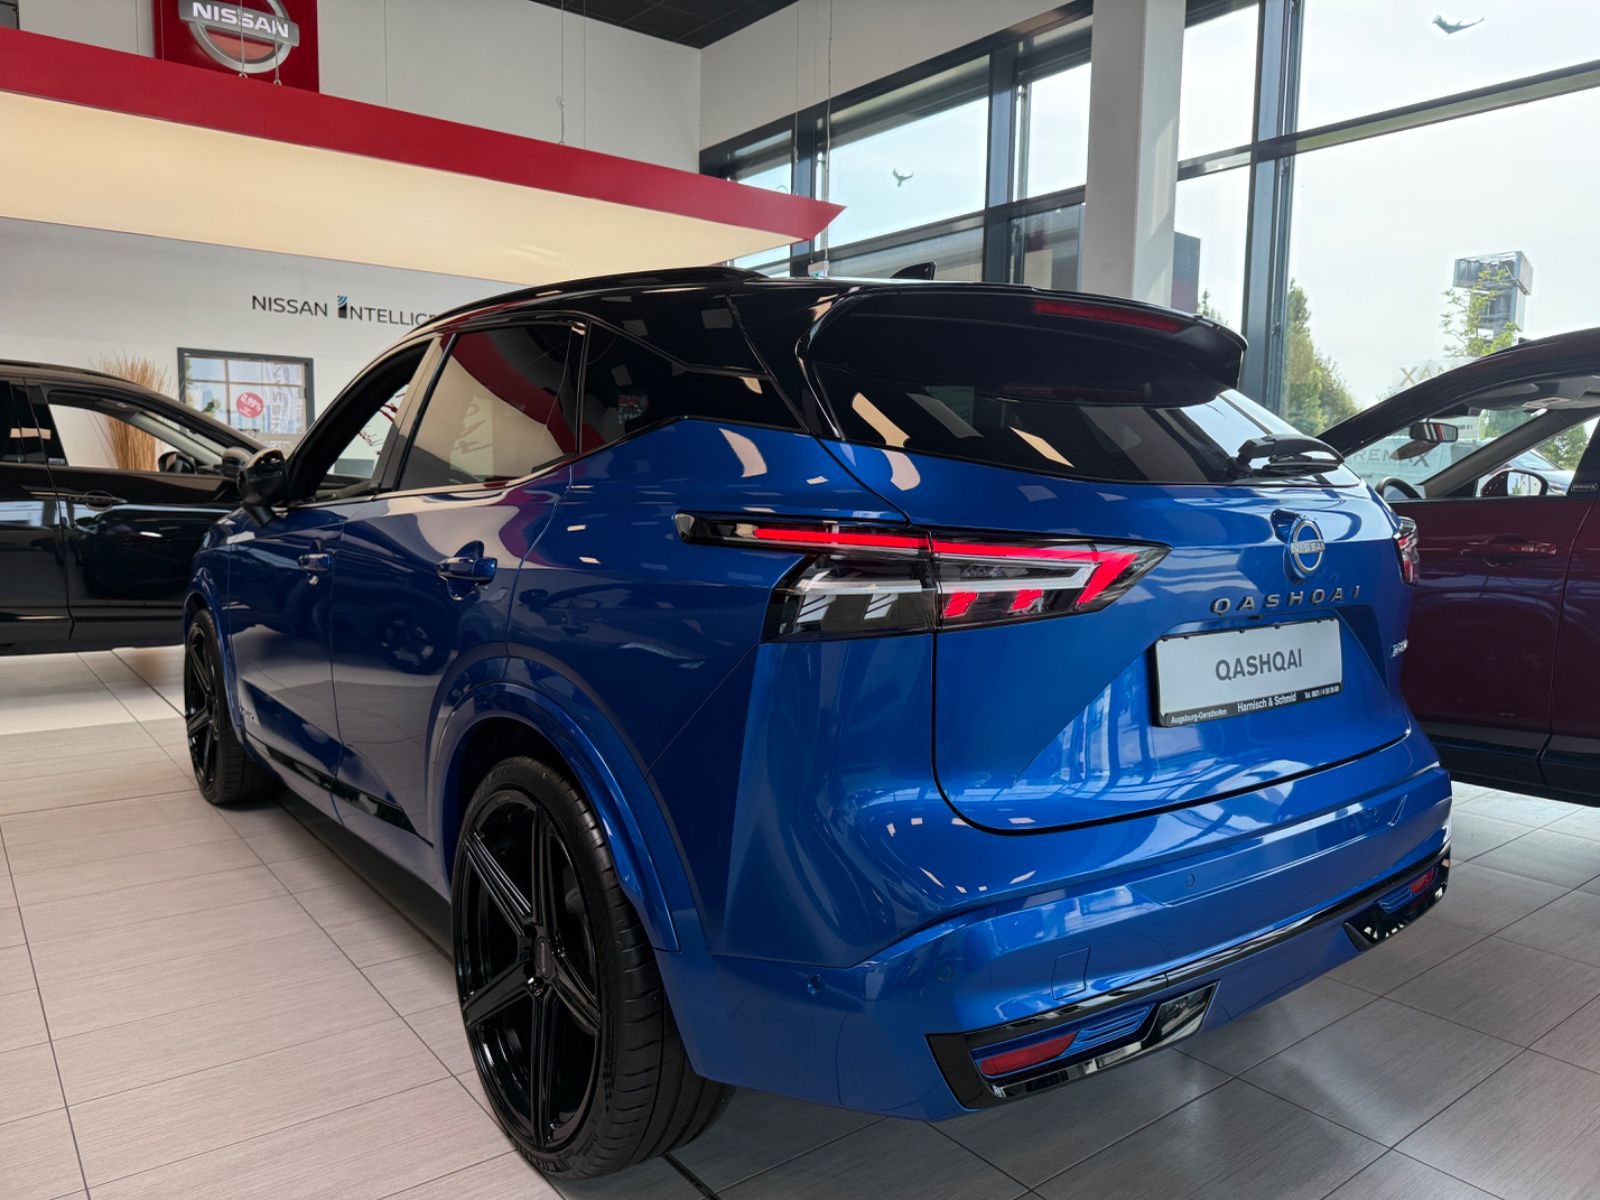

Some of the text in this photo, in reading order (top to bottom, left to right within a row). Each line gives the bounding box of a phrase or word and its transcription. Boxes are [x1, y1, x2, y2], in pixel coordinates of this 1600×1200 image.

[192, 2, 289, 38] NISSAN
[252, 295, 328, 317] NISSAN
[1215, 648, 1303, 681] QASHQAI
[1237, 692, 1297, 713] Harnisch & Schmid
